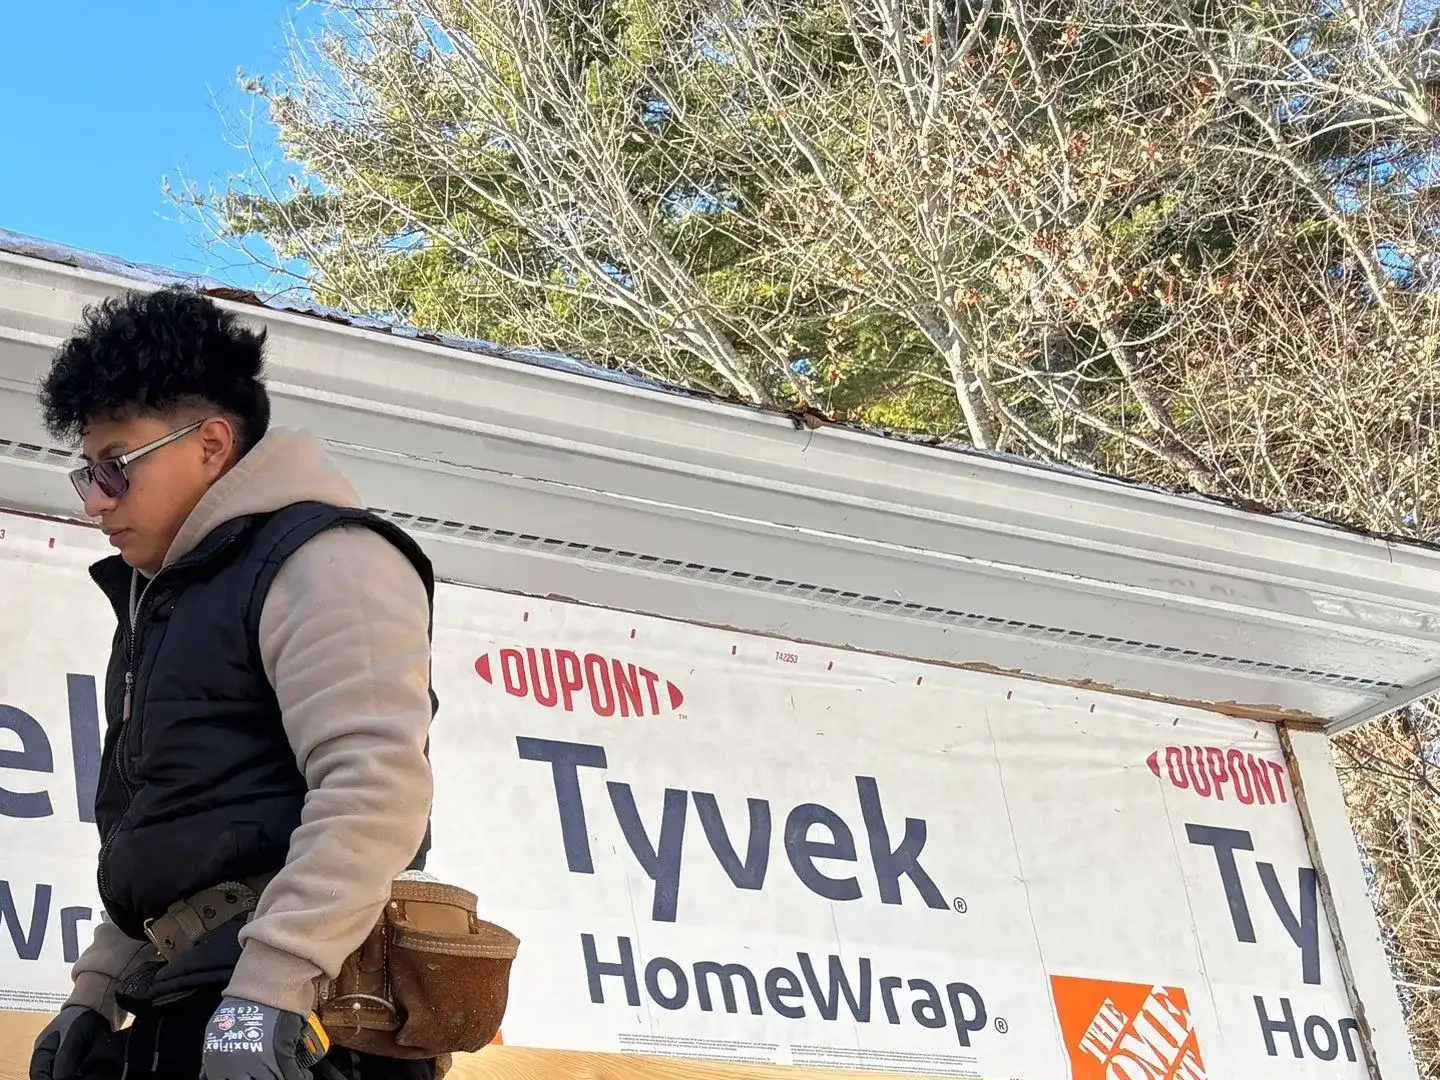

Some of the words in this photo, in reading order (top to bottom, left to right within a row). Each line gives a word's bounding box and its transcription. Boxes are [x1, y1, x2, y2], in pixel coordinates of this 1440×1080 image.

[500, 648, 659, 717] DUPONT
[1165, 745, 1288, 805] DUPONT
[205, 1041, 263, 1053] MaxiFlex
[1078, 996, 1129, 1065] THE
